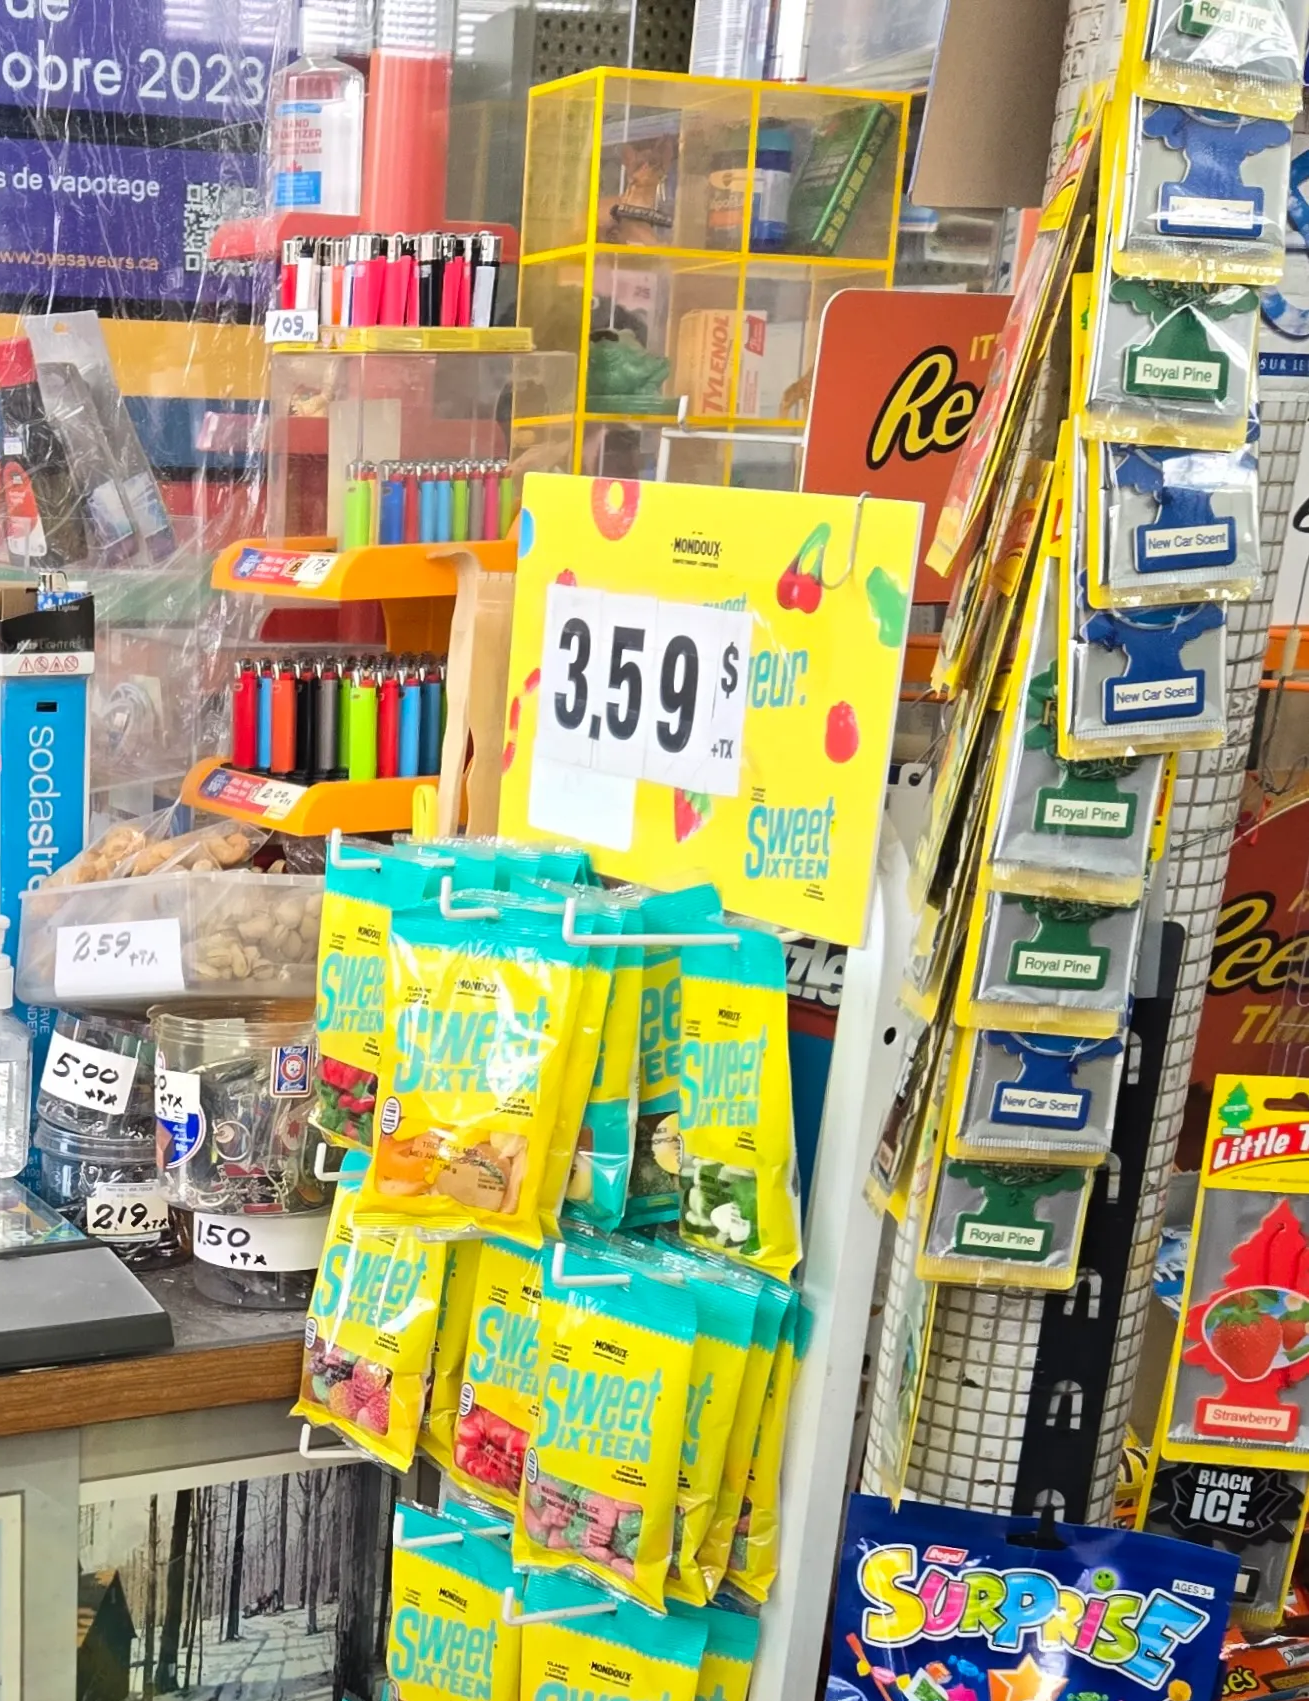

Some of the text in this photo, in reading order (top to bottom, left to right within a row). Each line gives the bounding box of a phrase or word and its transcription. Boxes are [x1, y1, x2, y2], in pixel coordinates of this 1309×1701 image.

[138, 48, 264, 104] 2023
[13, 166, 42, 190] de
[49, 175, 160, 200] vapotage
[702, 315, 730, 414] TYLENOL
[1144, 363, 1212, 383] Royal Pine
[674, 537, 721, 558] MONDOUX
[1148, 531, 1227, 549] New Car Scent
[554, 617, 738, 754] 3.59 $
[1116, 684, 1195, 704] New Car Scent
[1052, 804, 1120, 822] Royal Pine
[73, 931, 130, 963] 2.59
[1024, 956, 1091, 974] Royal Pine
[53, 1052, 119, 1085] 5.00
[1003, 1096, 1079, 1112] New Car Scent
[1213, 1127, 1291, 1169] Little
[970, 1227, 1035, 1246] Royal Pine
[1212, 1408, 1282, 1430] Strawberry
[1198, 1470, 1254, 1491] BLACK
[1175, 1582, 1213, 1597] AGES 3+
[859, 1544, 1209, 1689] SURPRISE
[591, 1661, 632, 1682] MONDOUX
